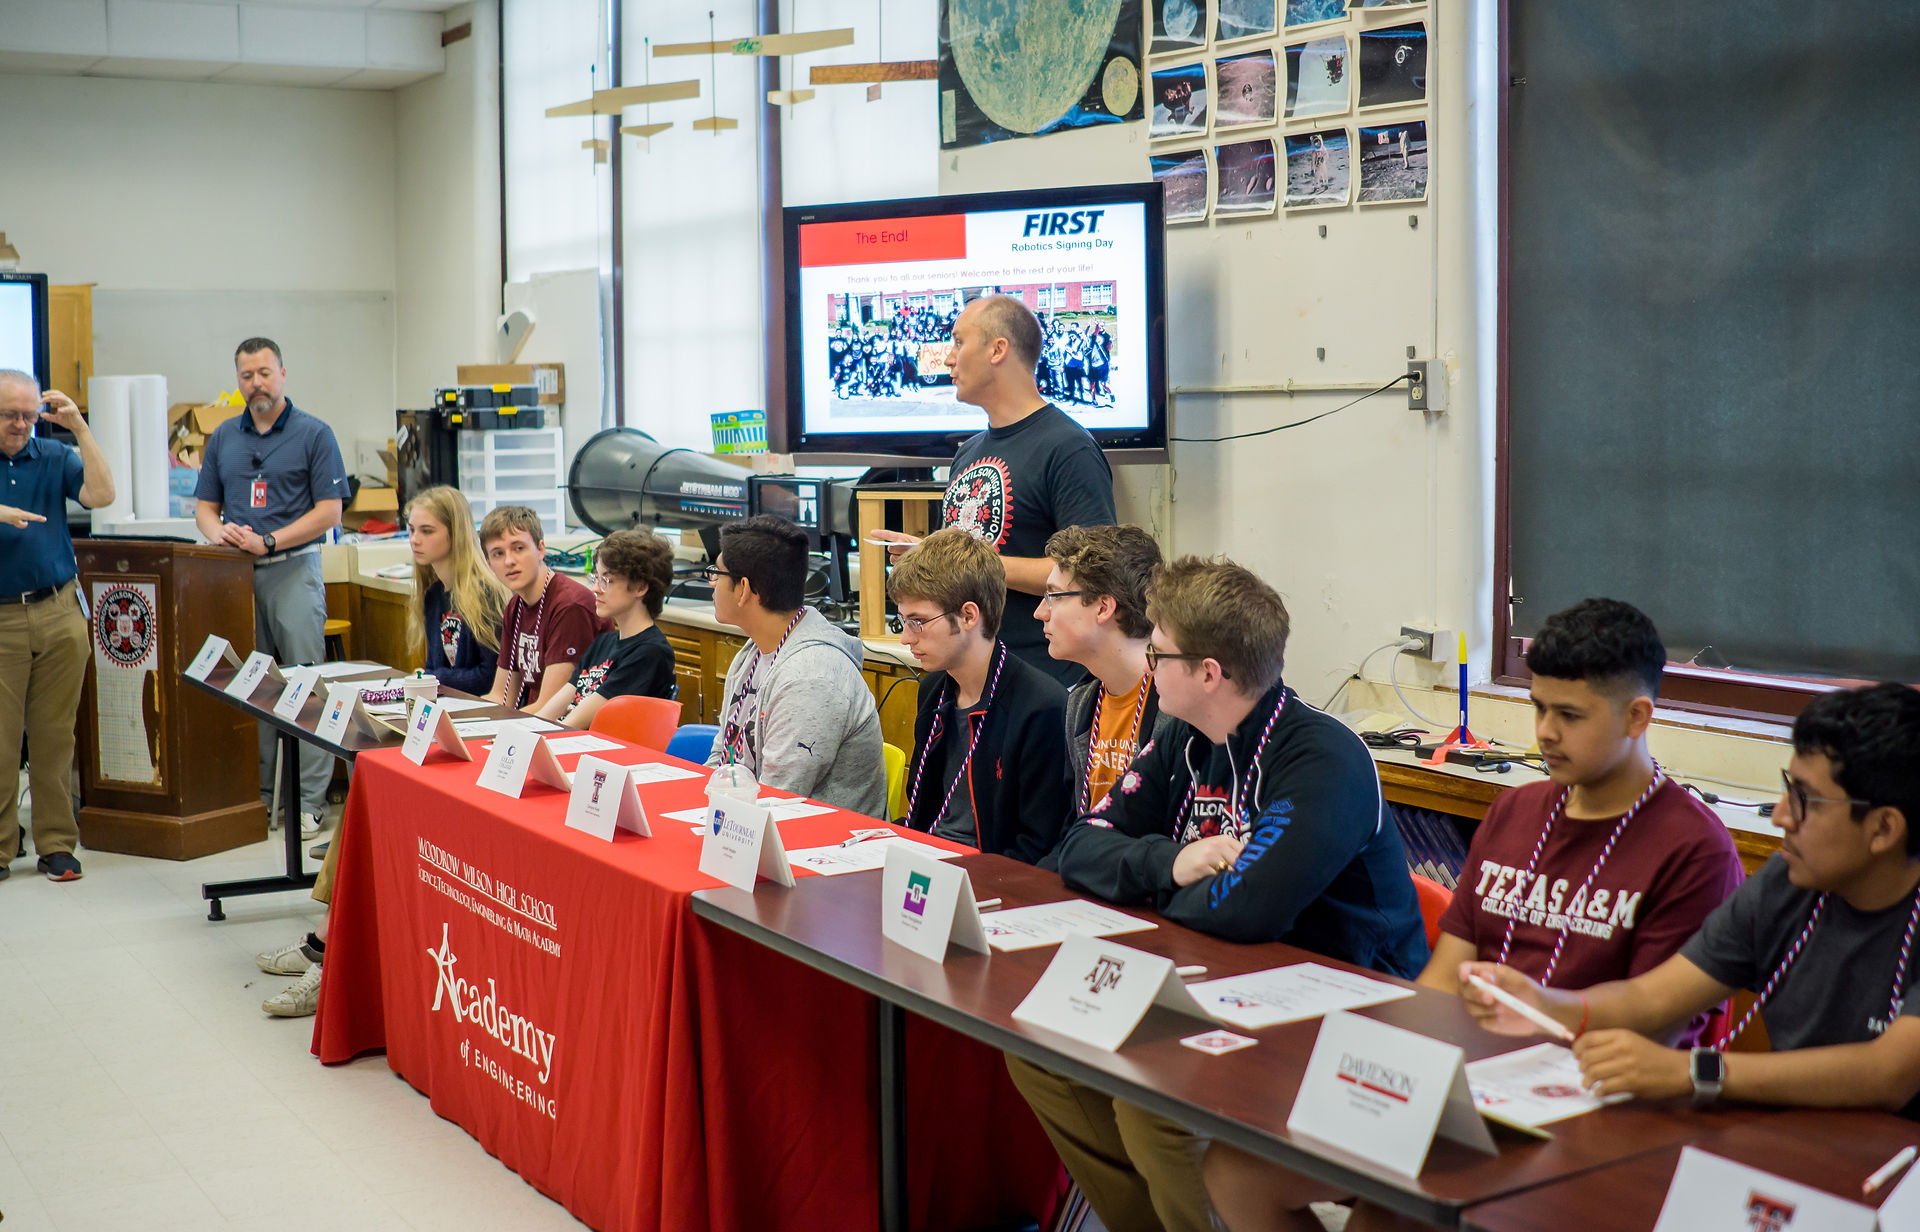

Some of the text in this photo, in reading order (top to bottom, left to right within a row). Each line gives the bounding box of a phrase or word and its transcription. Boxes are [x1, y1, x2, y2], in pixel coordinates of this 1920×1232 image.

[856, 230, 909, 244] The End!
[1023, 210, 1105, 237] FIRST
[1011, 239, 1114, 252] Robotics Signing Day
[848, 263, 1094, 284] Thank you to all our seniors! Welcome to the rest of your life!
[962, 468, 993, 483] WILSON
[990, 473, 1000, 497] HIGH
[986, 499, 1001, 541] SCHOO
[108, 592, 132, 604] WILSON
[721, 831, 754, 847] UNIVERSITY
[418, 835, 557, 927] WOODROW WILSON HIGH SCHOOL
[1475, 860, 1641, 929] TEXAS A&M
[1481, 896, 1528, 922] COLLEE
[1529, 909, 1546, 926] OF
[514, 920, 532, 943] MATH
[532, 930, 561, 957] ACADEMY
[427, 922, 556, 1084] Academy
[460, 1038, 556, 1119] of ENGINEERING
[1338, 1051, 1416, 1096] DAVIDSON
